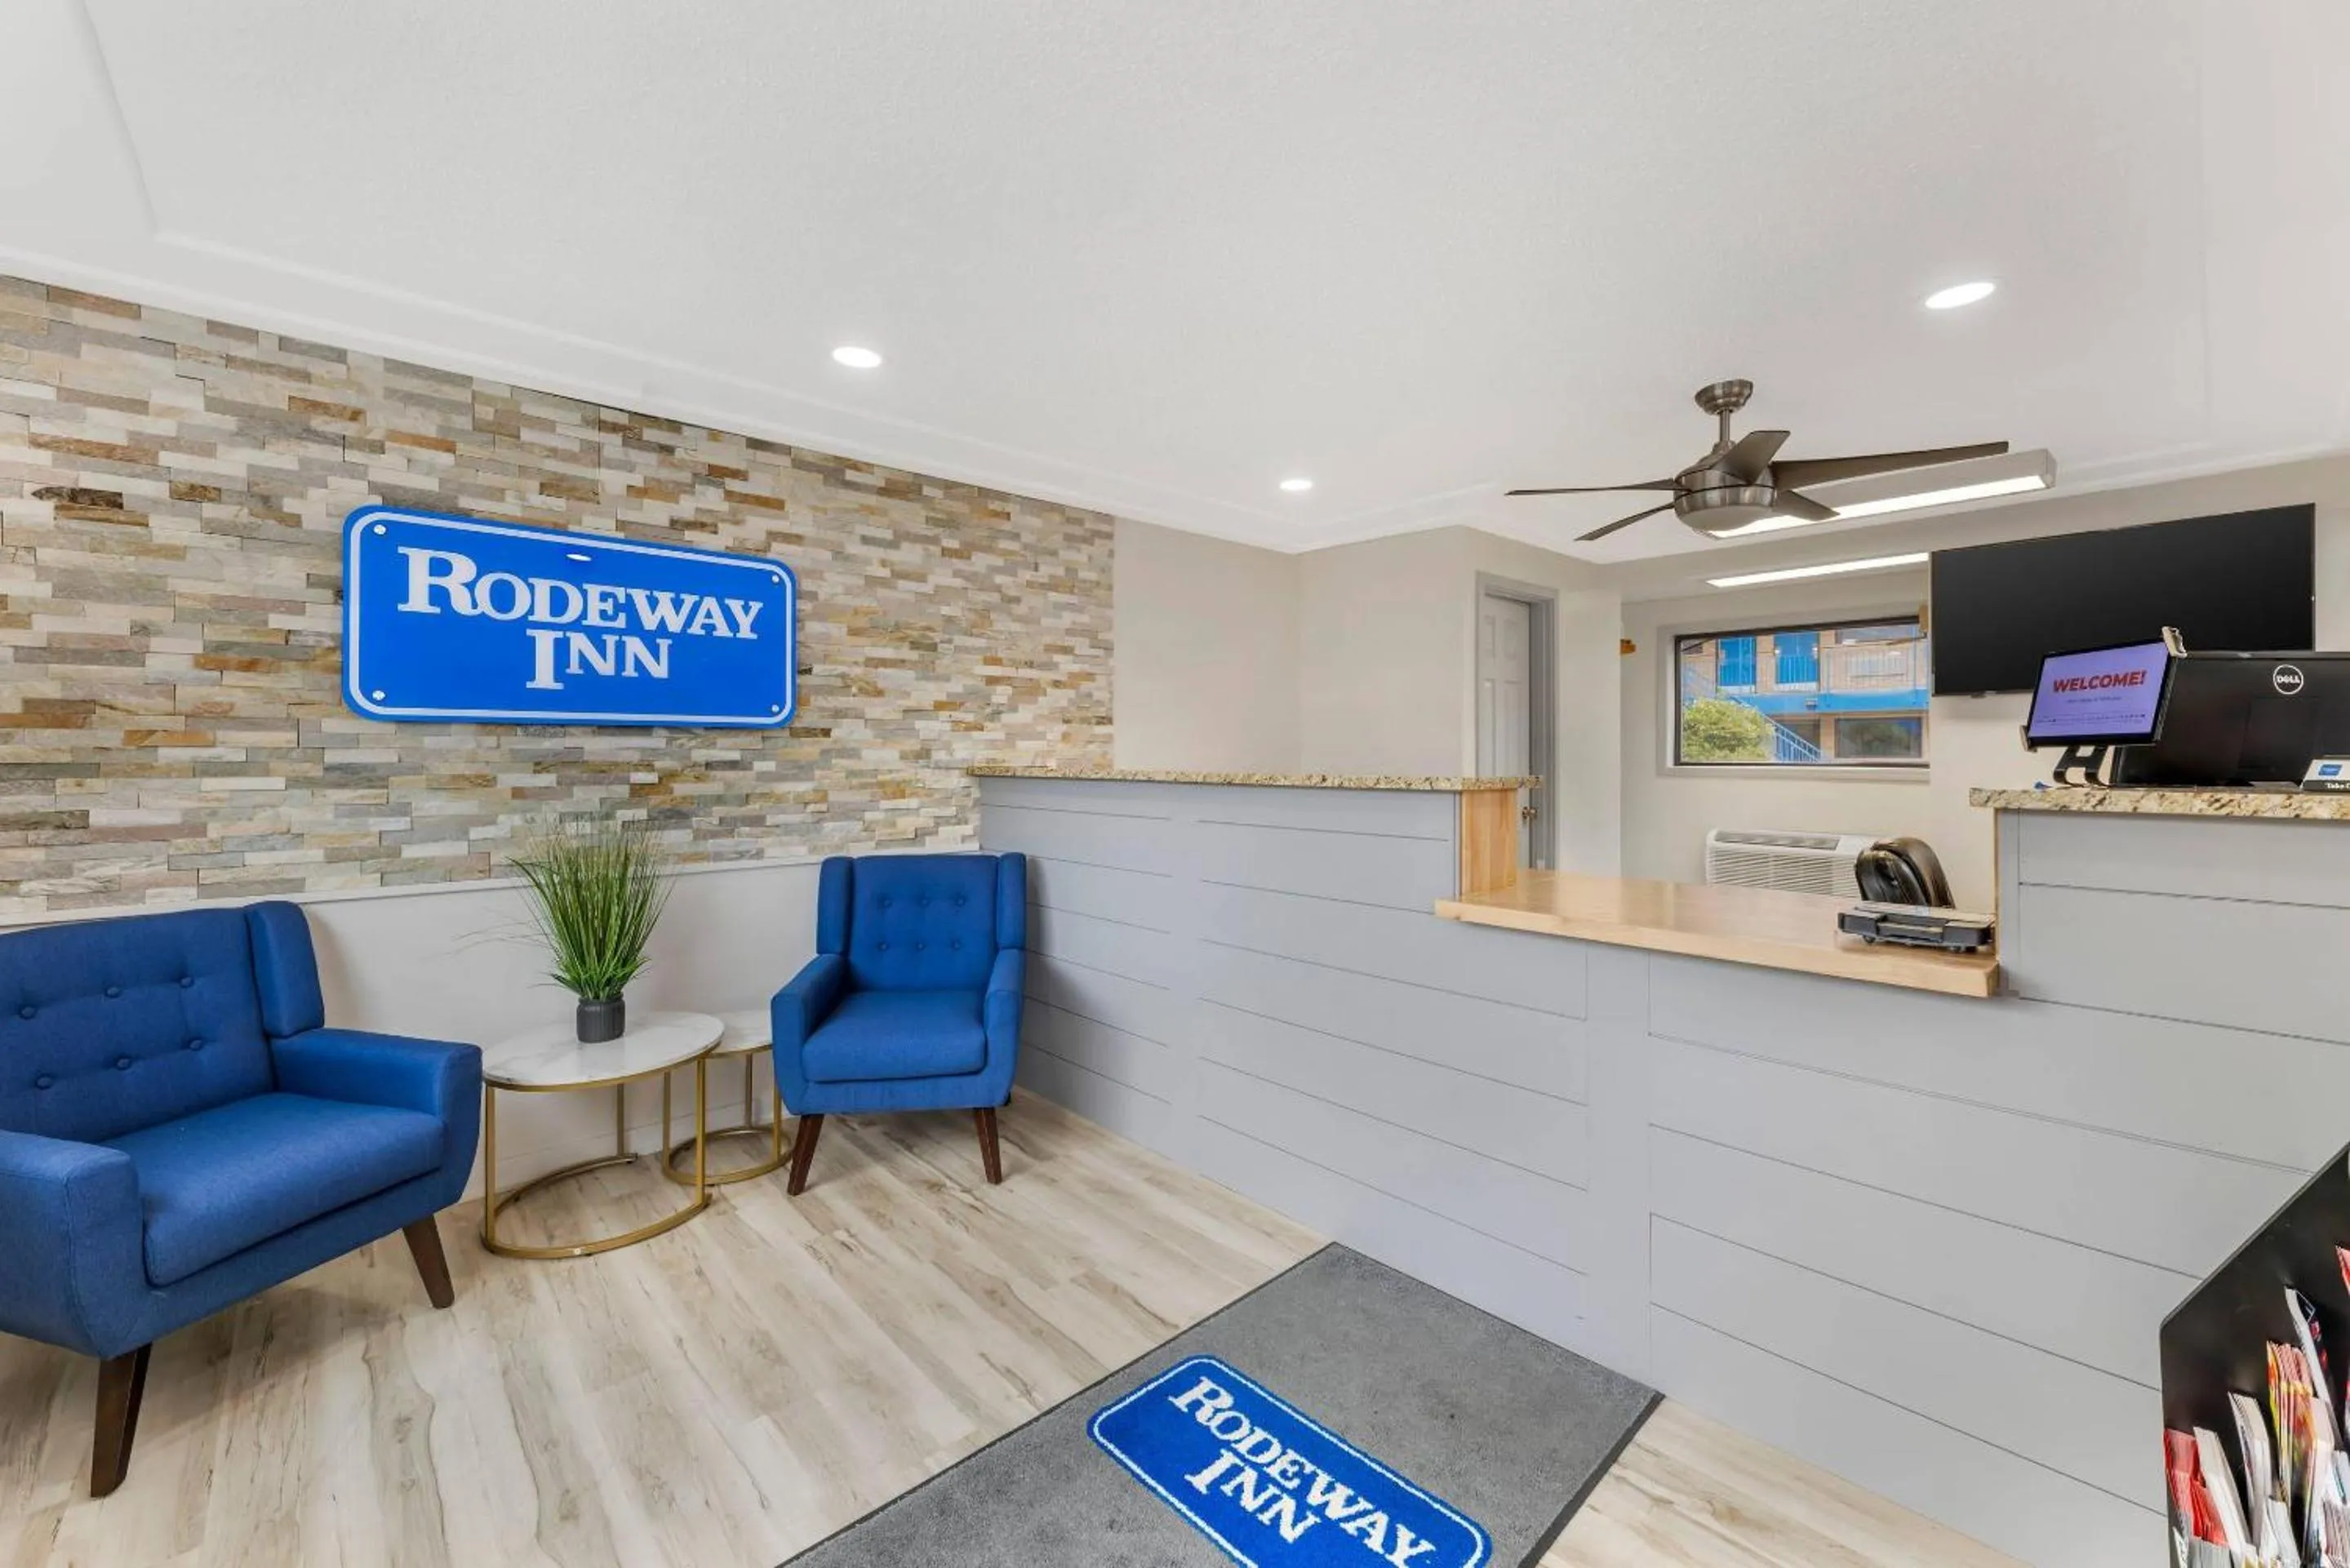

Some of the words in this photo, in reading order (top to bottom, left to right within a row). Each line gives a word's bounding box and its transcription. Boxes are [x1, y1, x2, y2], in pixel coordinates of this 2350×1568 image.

[397, 546, 764, 640] RODEWAY
[526, 628, 673, 691] INN
[2053, 670, 2148, 693] WELCOME!
[2277, 675, 2300, 684] DELL
[1168, 1376, 1436, 1568] RODEWAY
[1184, 1448, 1321, 1544] INN
